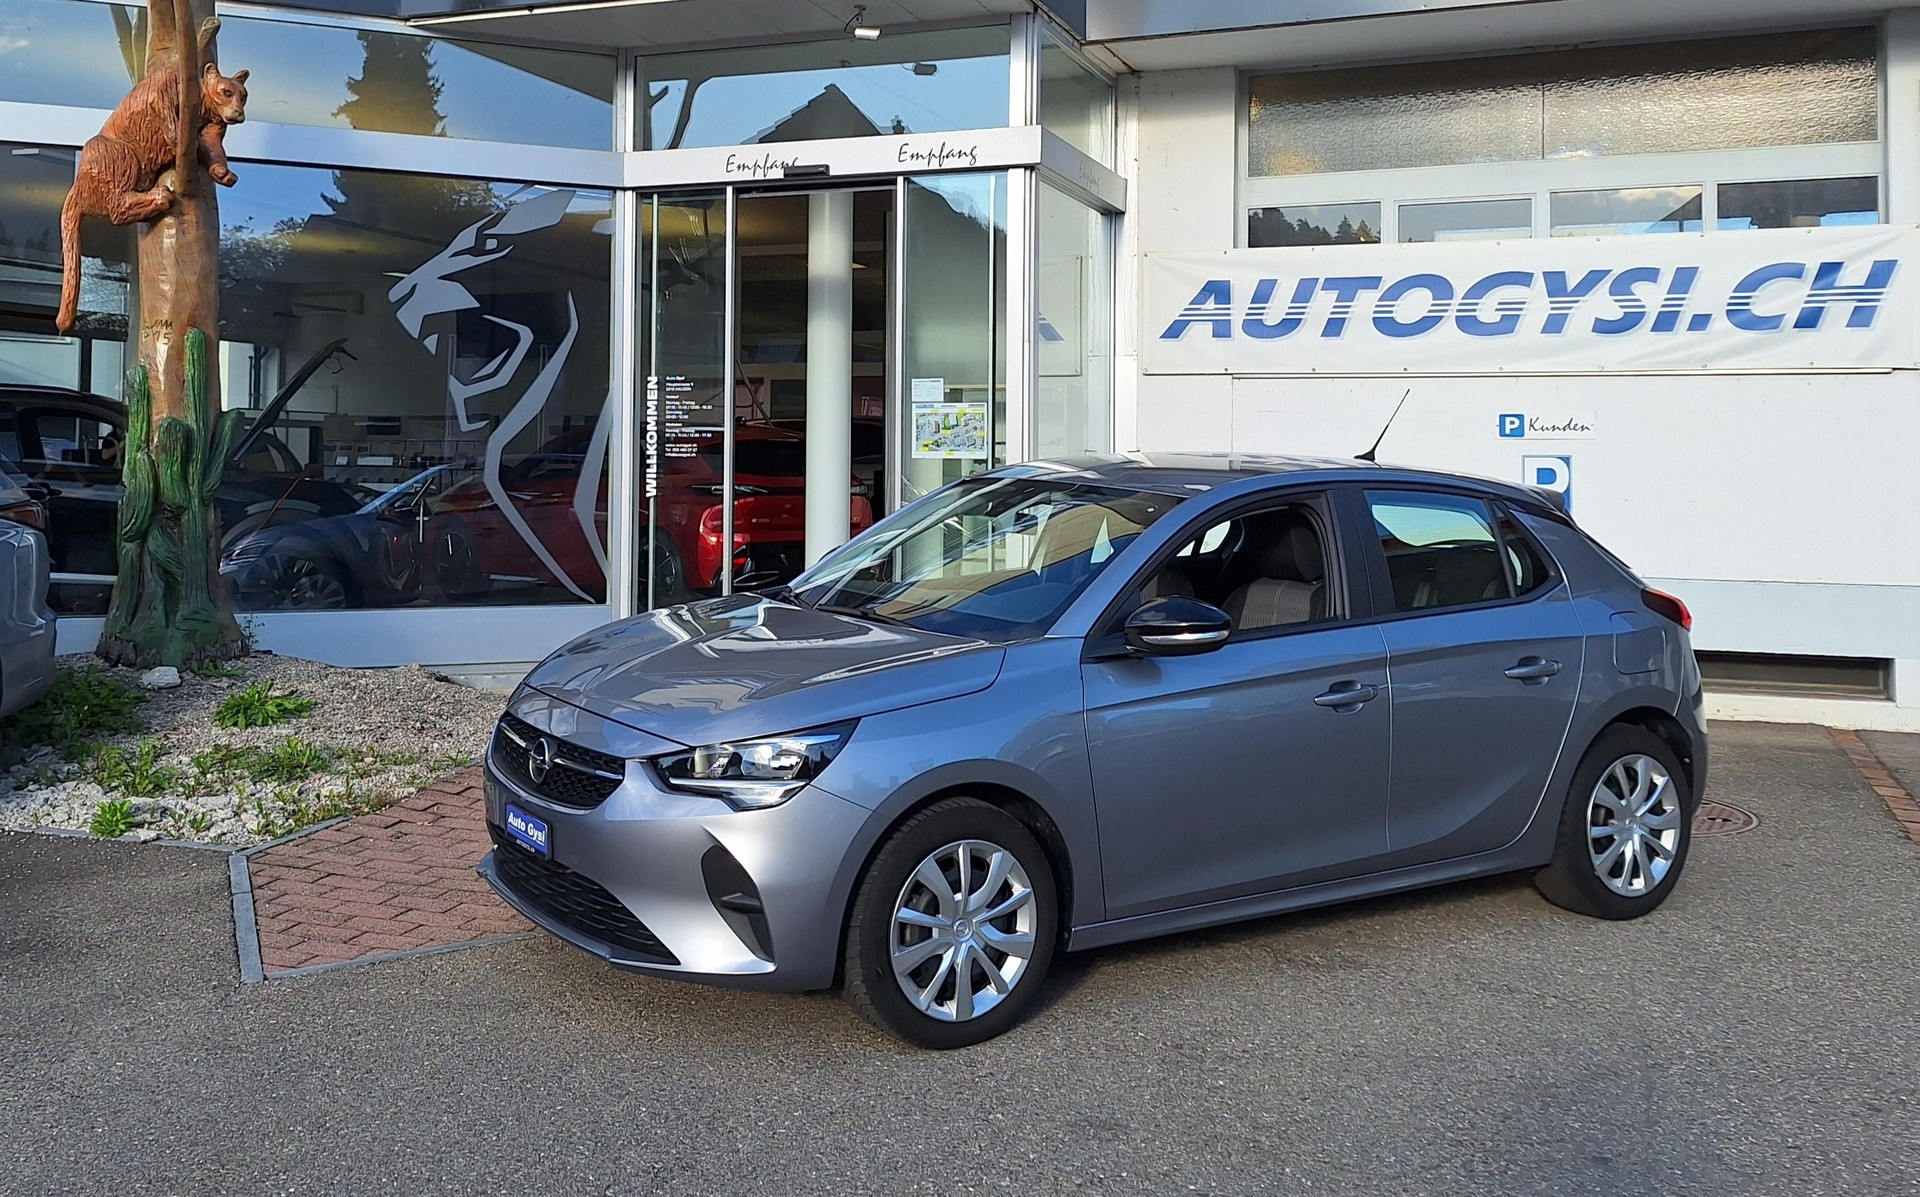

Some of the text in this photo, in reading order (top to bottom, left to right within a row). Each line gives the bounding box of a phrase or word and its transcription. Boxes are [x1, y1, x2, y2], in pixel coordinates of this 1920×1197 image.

[898, 141, 978, 167] Empfang
[1159, 259, 1899, 340] AUTOGYSI.CH
[645, 376, 658, 497] WILLKOMMEN
[1505, 416, 1591, 434] P Kunden
[508, 811, 545, 843] Auto Gysi
